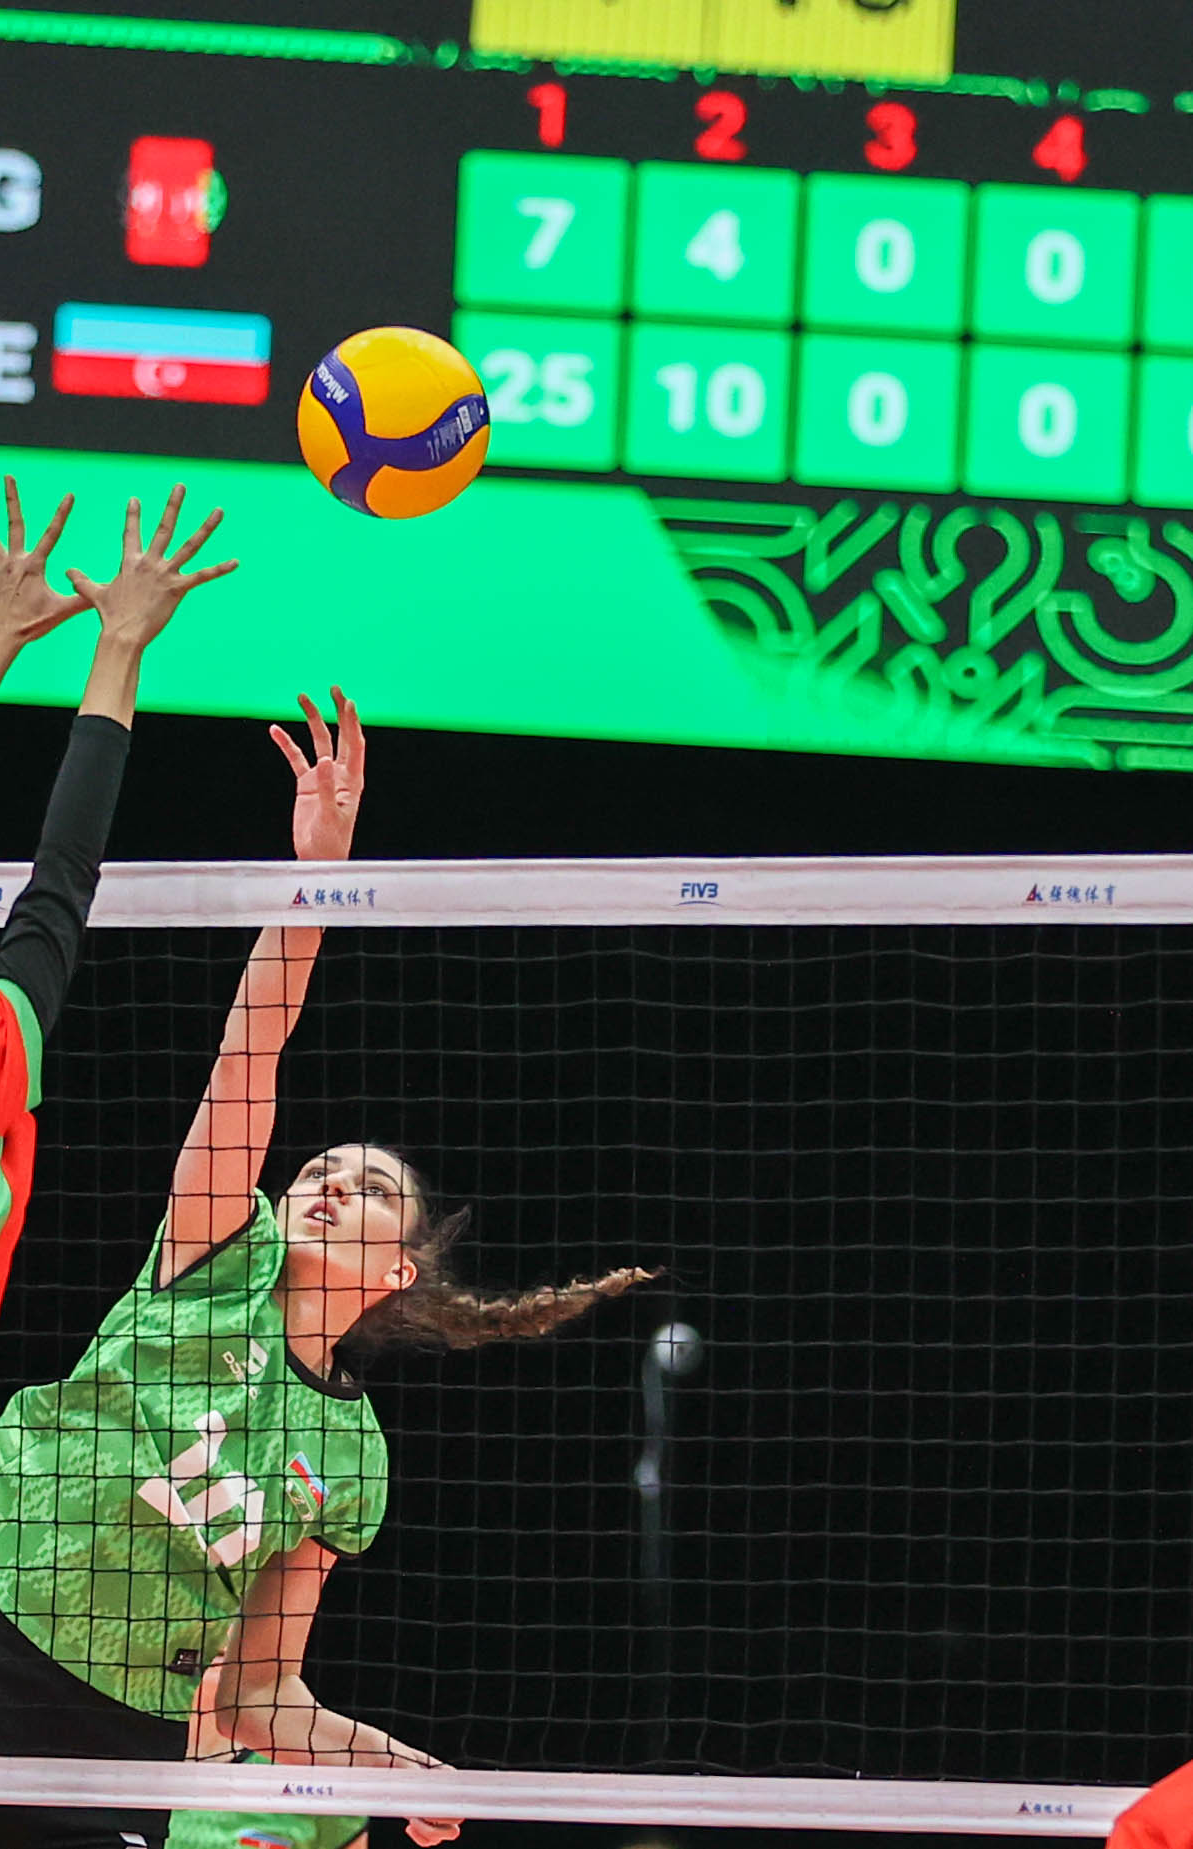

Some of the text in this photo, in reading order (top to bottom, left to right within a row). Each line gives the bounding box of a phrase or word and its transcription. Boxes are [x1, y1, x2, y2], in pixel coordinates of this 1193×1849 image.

[527, 83, 1088, 182] 1 2 3 4
[518, 197, 1086, 304] 7 4 0 0
[481, 350, 1078, 458] 25 10 0 0
